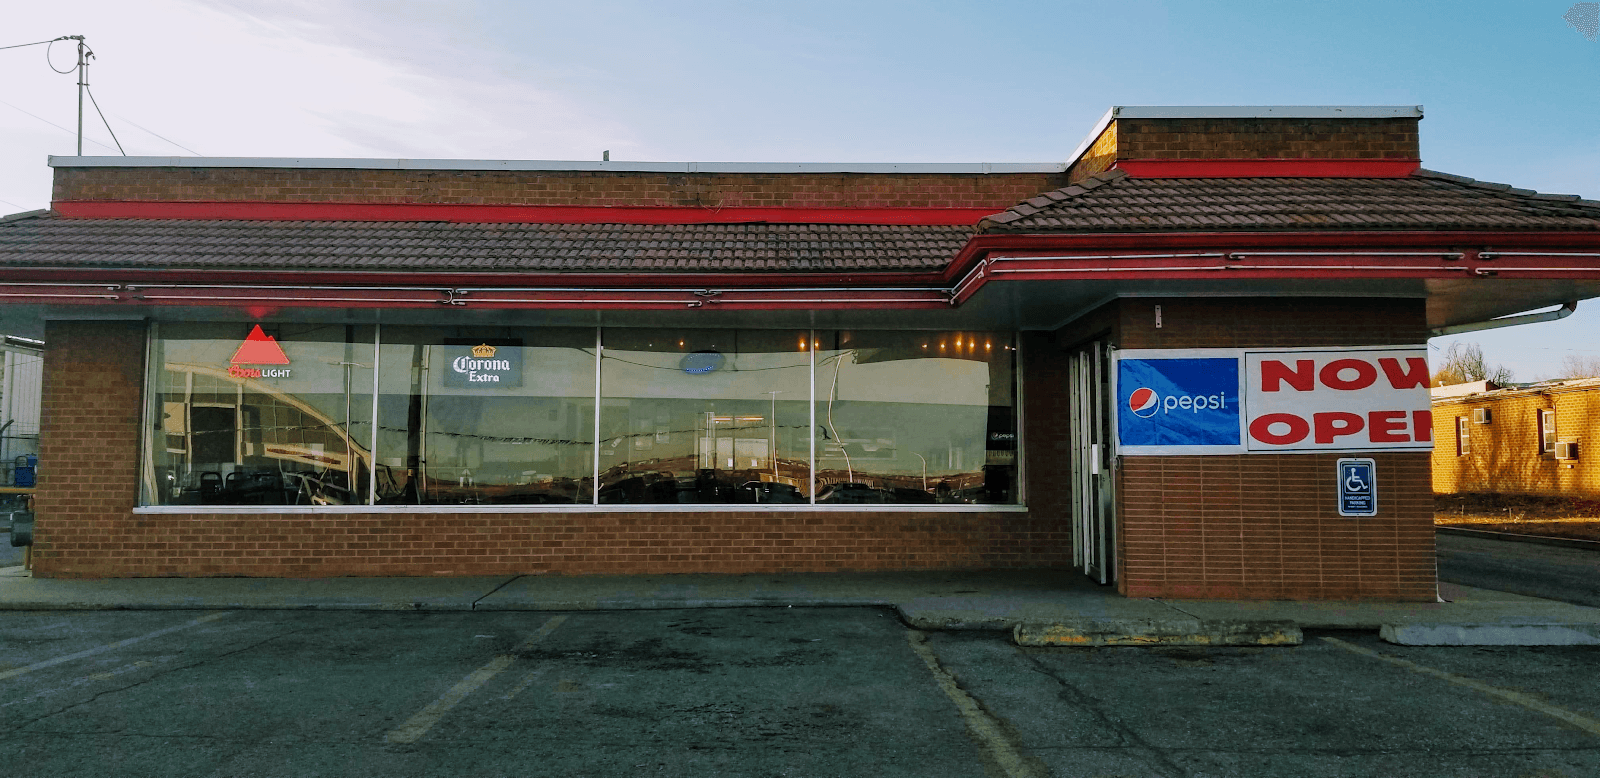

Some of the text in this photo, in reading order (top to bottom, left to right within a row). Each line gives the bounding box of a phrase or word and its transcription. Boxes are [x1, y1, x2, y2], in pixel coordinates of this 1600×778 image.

[228, 364, 291, 378] Coors LIGHT
[452, 355, 511, 374] Corona
[468, 370, 500, 382] Extra
[1261, 357, 1432, 392] NOW
[1164, 391, 1225, 414] pepsi
